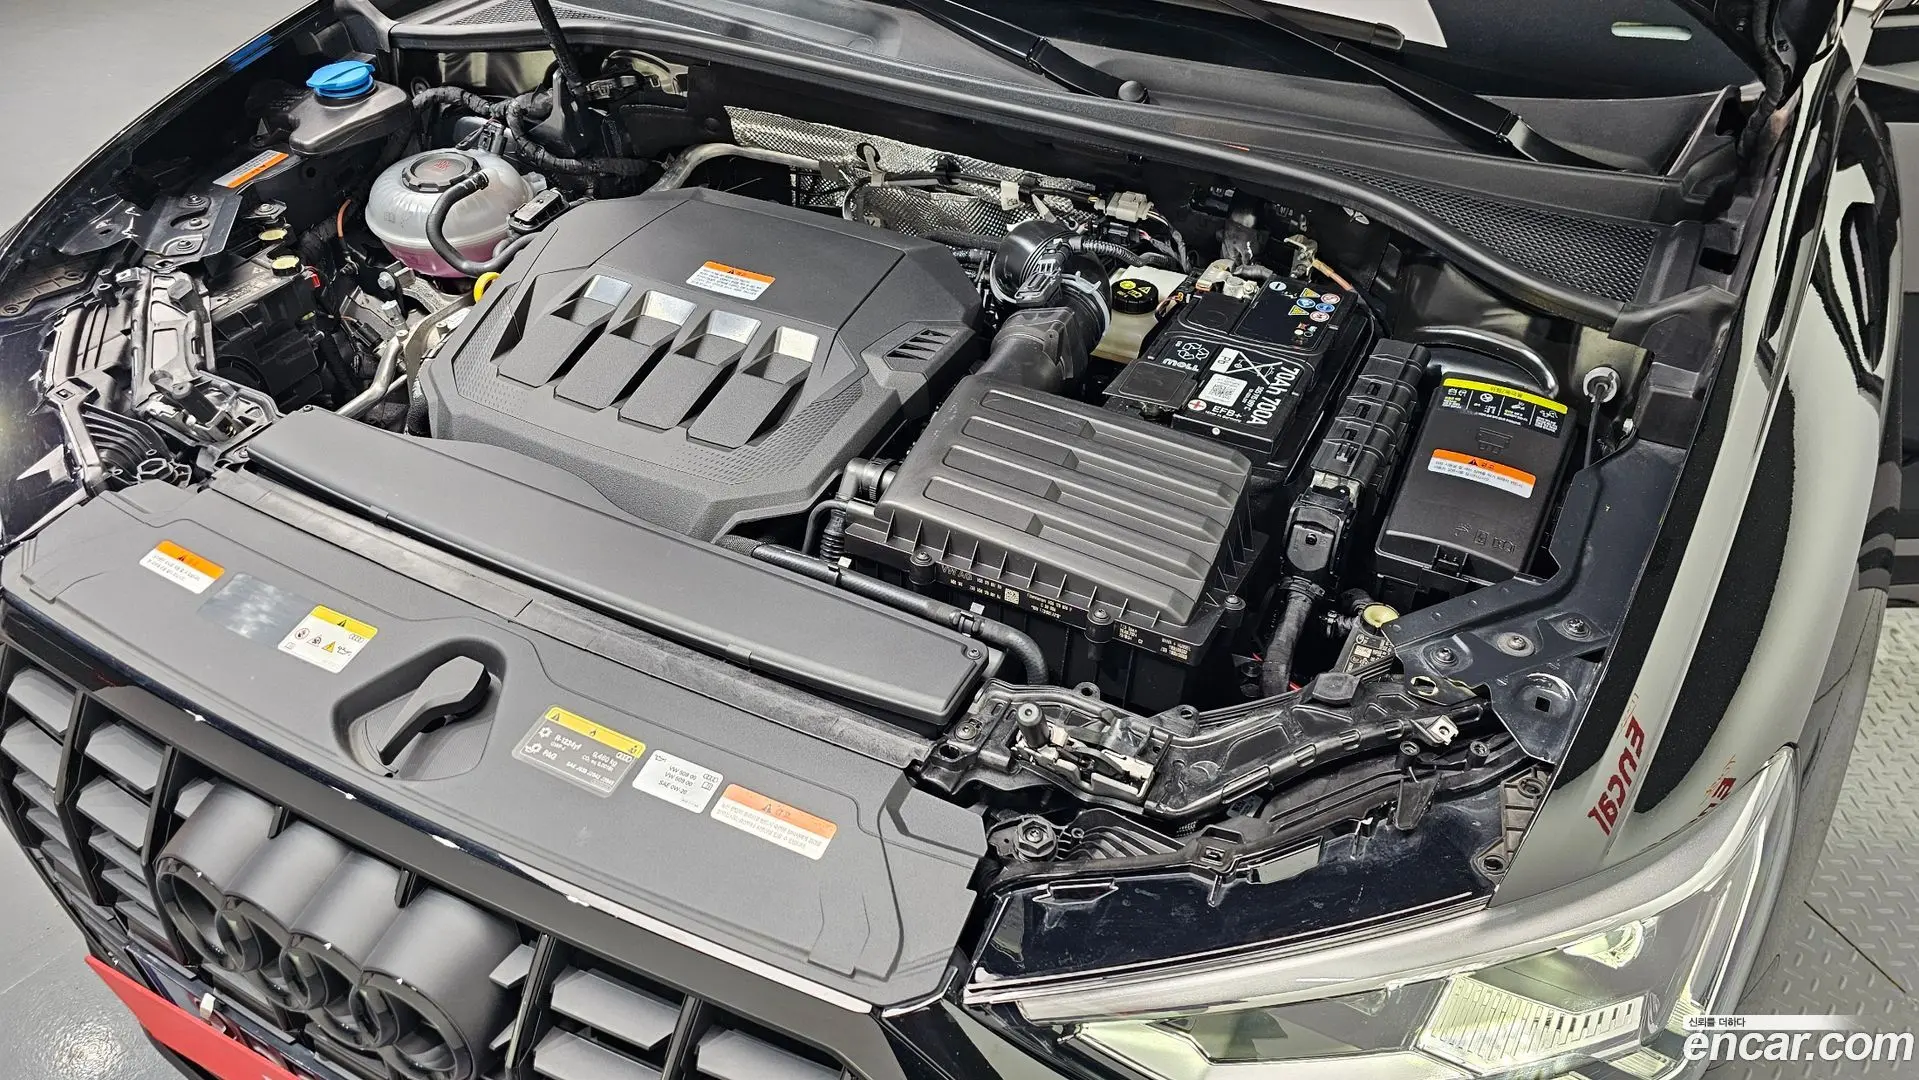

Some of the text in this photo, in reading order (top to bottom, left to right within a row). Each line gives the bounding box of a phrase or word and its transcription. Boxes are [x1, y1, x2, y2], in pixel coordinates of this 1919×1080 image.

[1266, 366, 1300, 395] 70Ah
[1212, 405, 1242, 418] EFB+
[1246, 396, 1281, 425] 700A
[665, 771, 675, 779] VW
[658, 780, 670, 788] SAE
